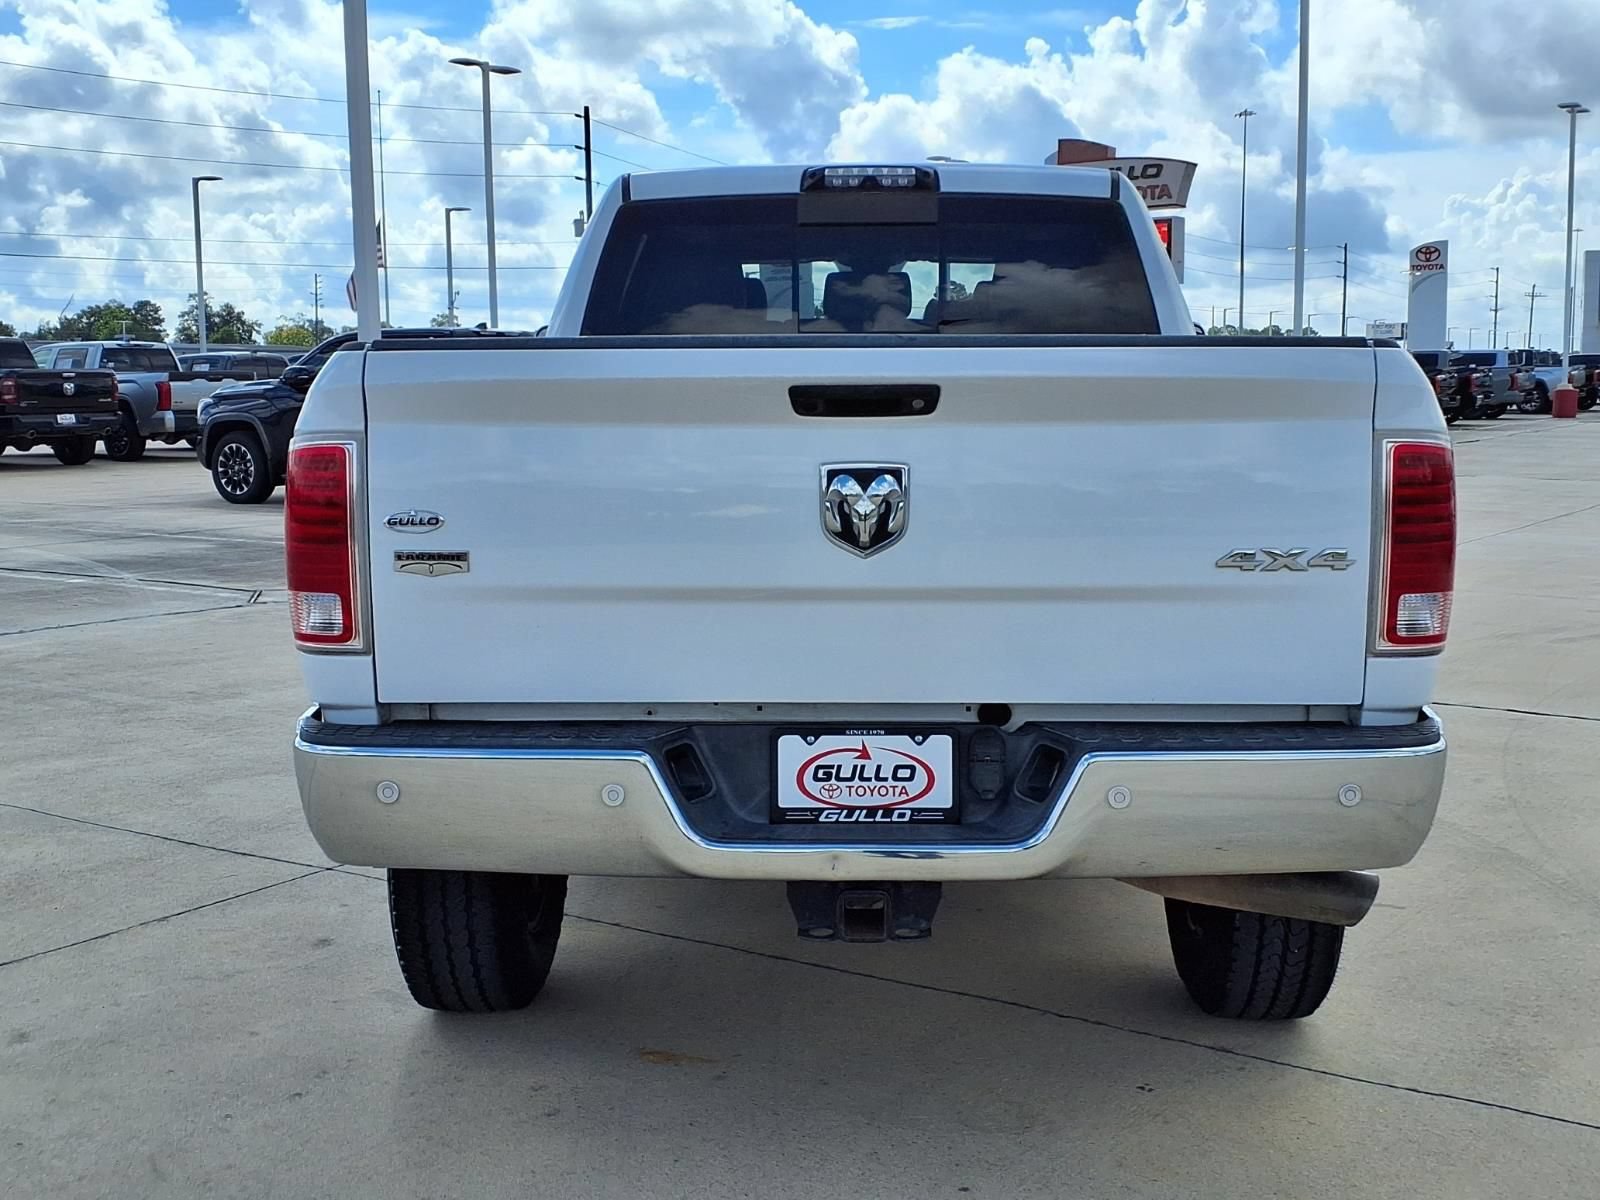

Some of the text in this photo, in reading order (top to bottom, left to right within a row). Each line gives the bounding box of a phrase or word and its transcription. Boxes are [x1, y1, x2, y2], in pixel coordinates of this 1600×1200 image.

[1136, 184, 1173, 200] OTA
[1411, 263, 1445, 271] TOYOTA
[387, 517, 440, 526] GULLO
[812, 764, 917, 782] GULLO
[846, 785, 910, 797] TOYOTA
[818, 809, 912, 822] GULLO
